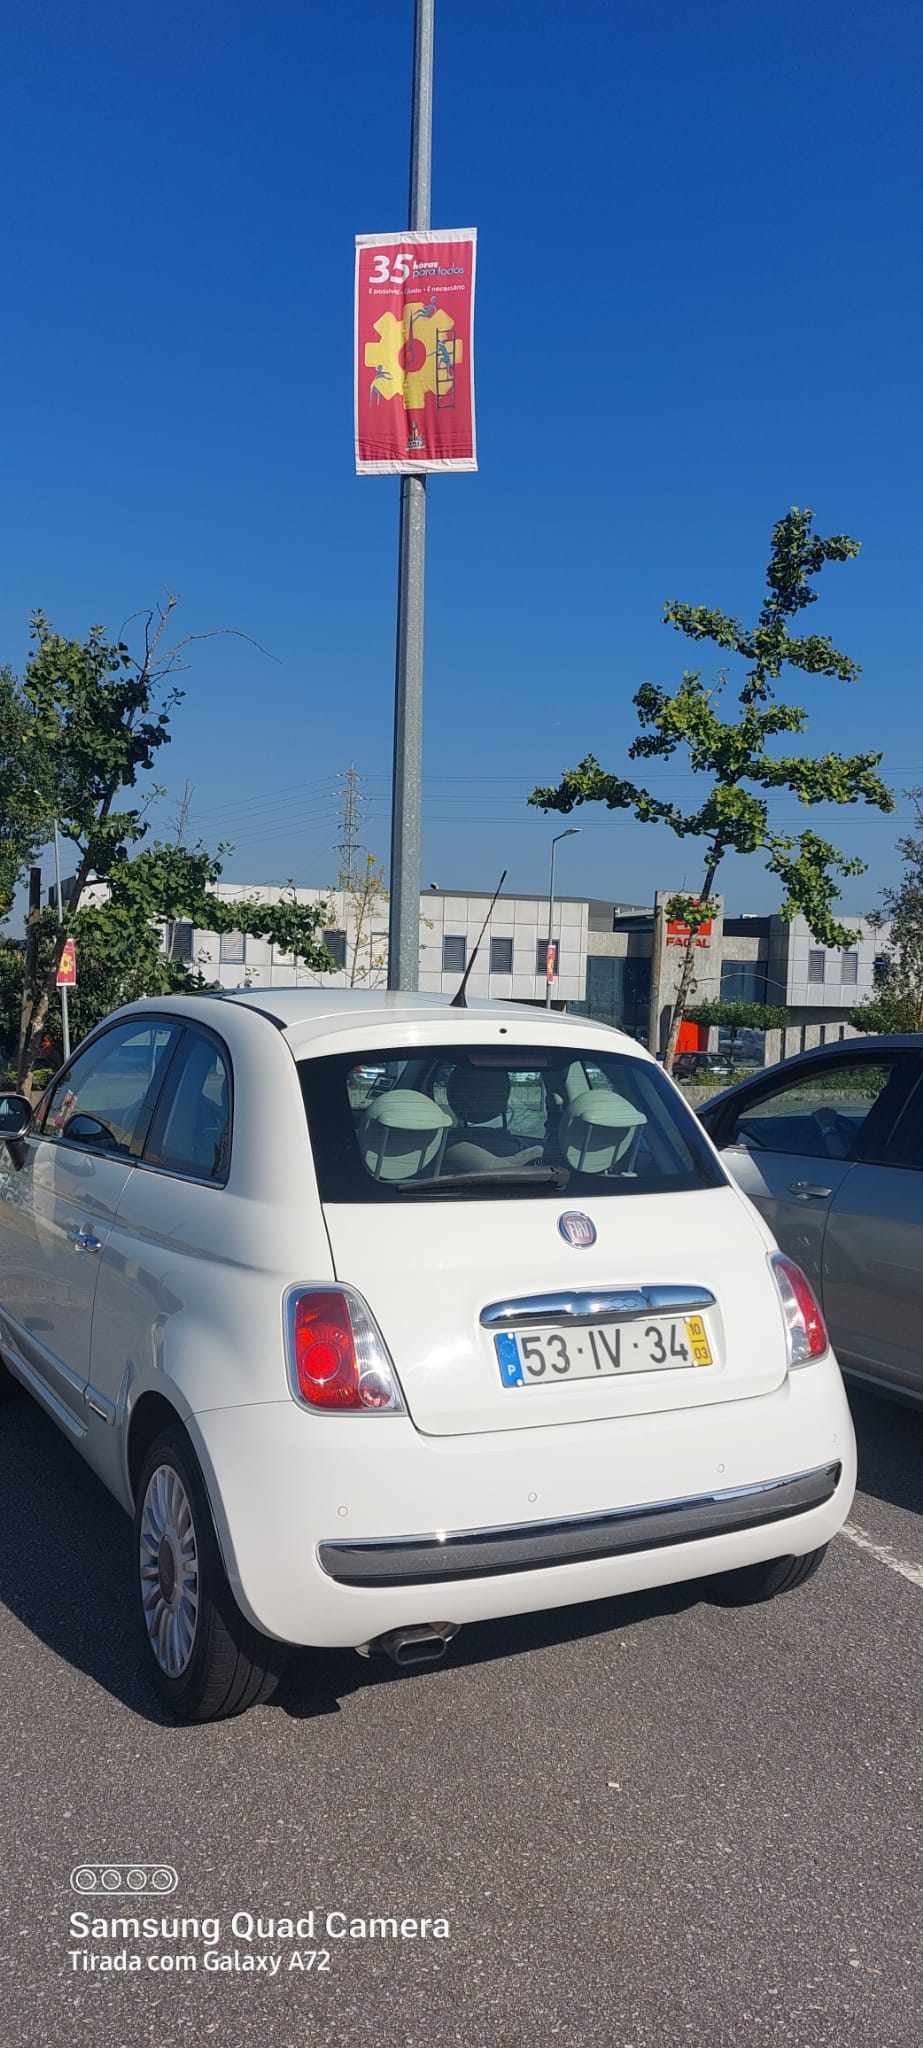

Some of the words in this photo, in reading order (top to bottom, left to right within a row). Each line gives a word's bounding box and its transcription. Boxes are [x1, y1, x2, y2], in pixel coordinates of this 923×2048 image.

[368, 253, 414, 284] 35
[413, 260, 439, 269] horas
[413, 268, 436, 280] para
[688, 1323, 701, 1335] 10
[694, 1348, 708, 1360] 03
[507, 1365, 516, 1376] P
